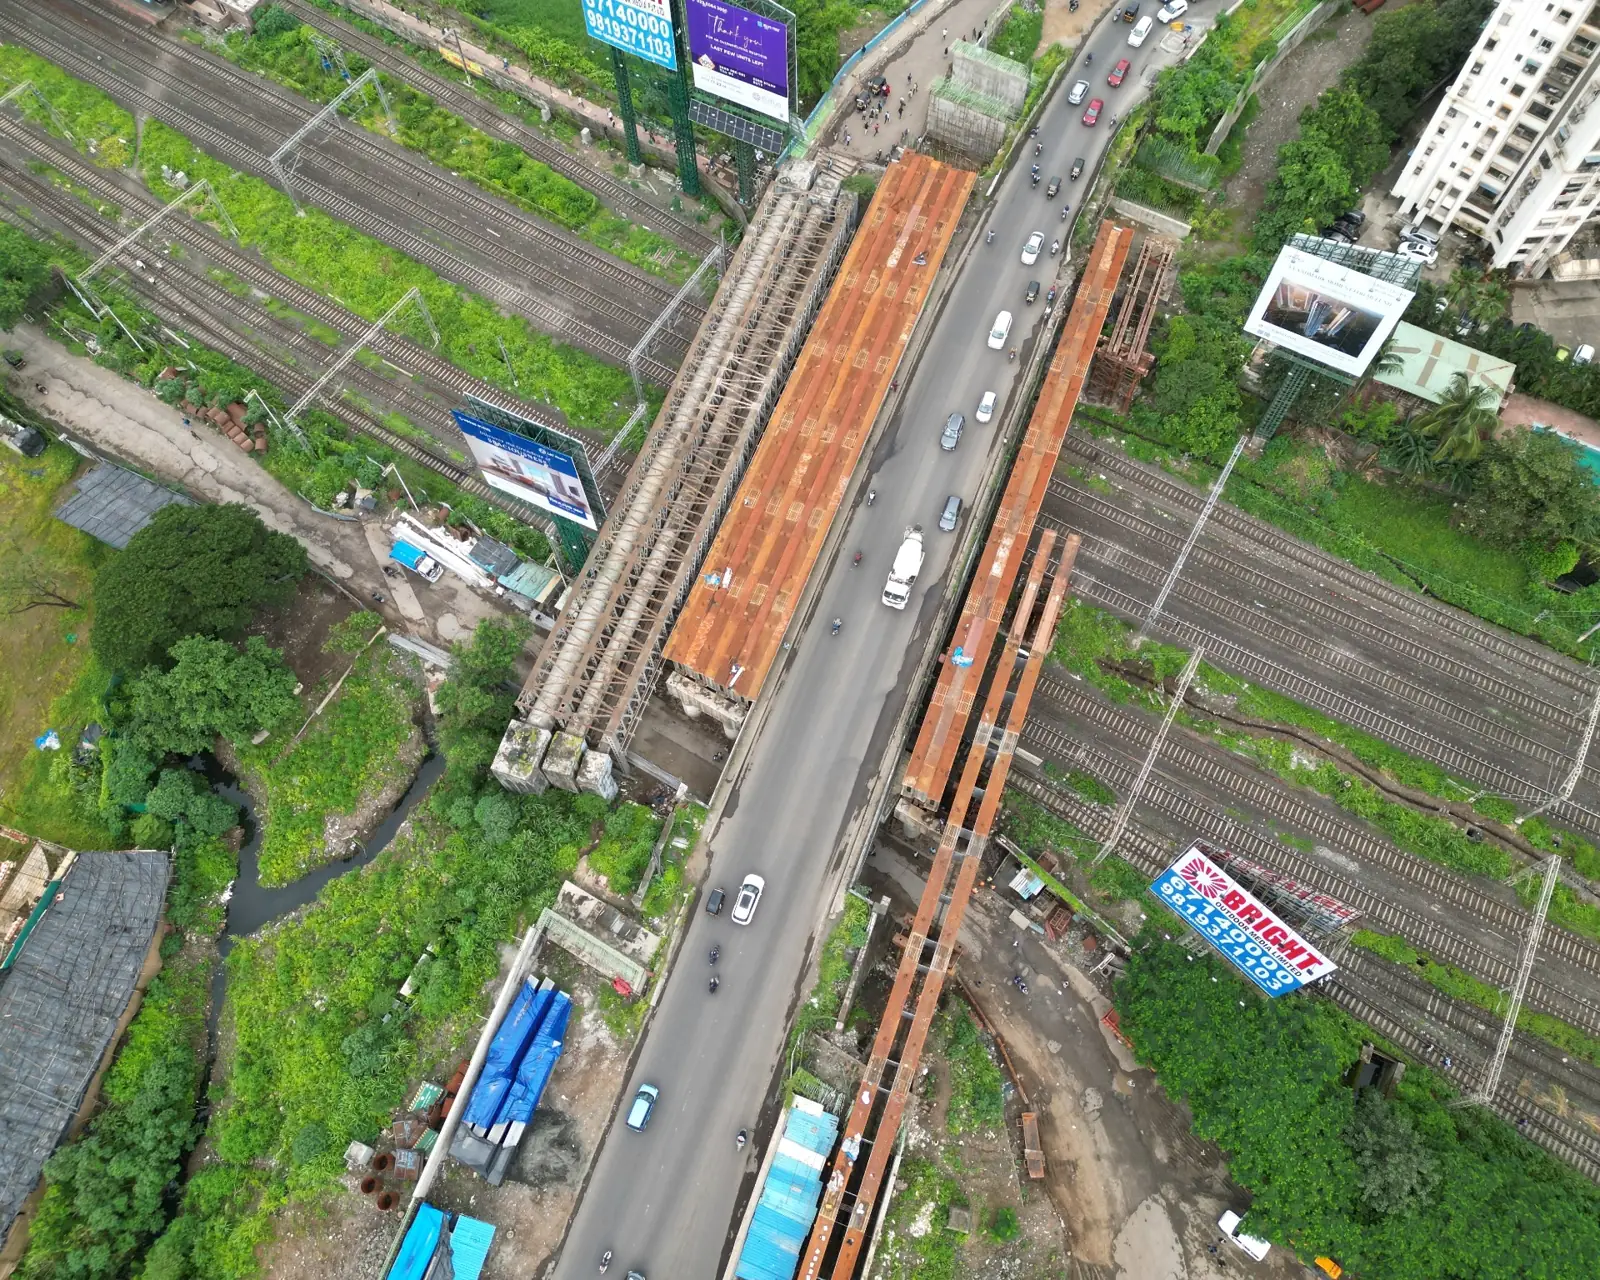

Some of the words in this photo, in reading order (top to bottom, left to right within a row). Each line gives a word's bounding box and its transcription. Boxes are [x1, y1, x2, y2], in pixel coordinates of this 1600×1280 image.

[587, 10, 672, 58] 9819371103
[708, 13, 742, 41] Thank
[743, 35, 763, 48] you
[710, 44, 723, 53] LAST
[723, 49, 736, 57] FEW
[736, 53, 751, 63] UNITS
[751, 59, 764, 67] LEFT
[1160, 882, 1282, 990] 9819371103
[1170, 875, 1294, 985] 67140000
[1215, 901, 1250, 932] OUTDOOR
[1249, 931, 1273, 951] MEDIA
[1272, 950, 1302, 977] LIMITED
[1221, 889, 1324, 970] BRIGHT
